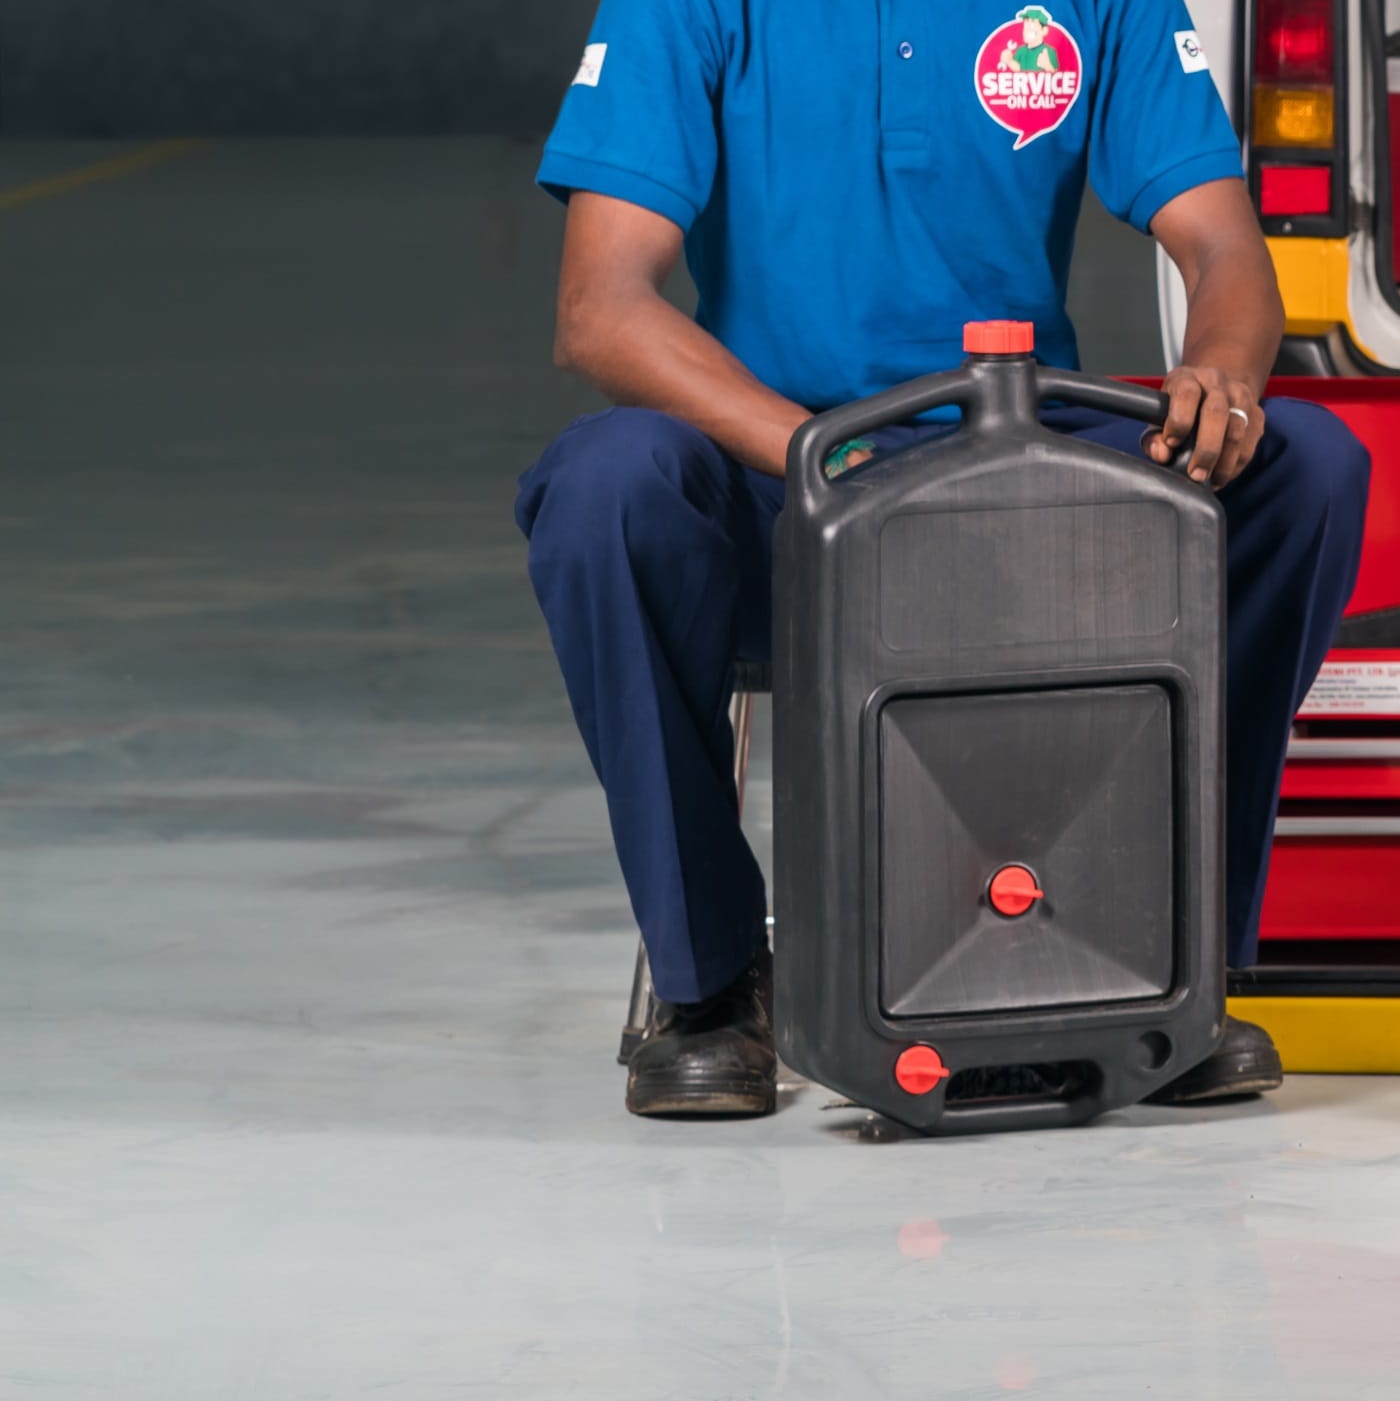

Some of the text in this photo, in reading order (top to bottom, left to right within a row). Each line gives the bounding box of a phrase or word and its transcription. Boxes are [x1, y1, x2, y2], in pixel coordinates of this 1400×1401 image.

[982, 72, 1077, 96] SERVICE
[1007, 95, 1056, 109] ON CALL
